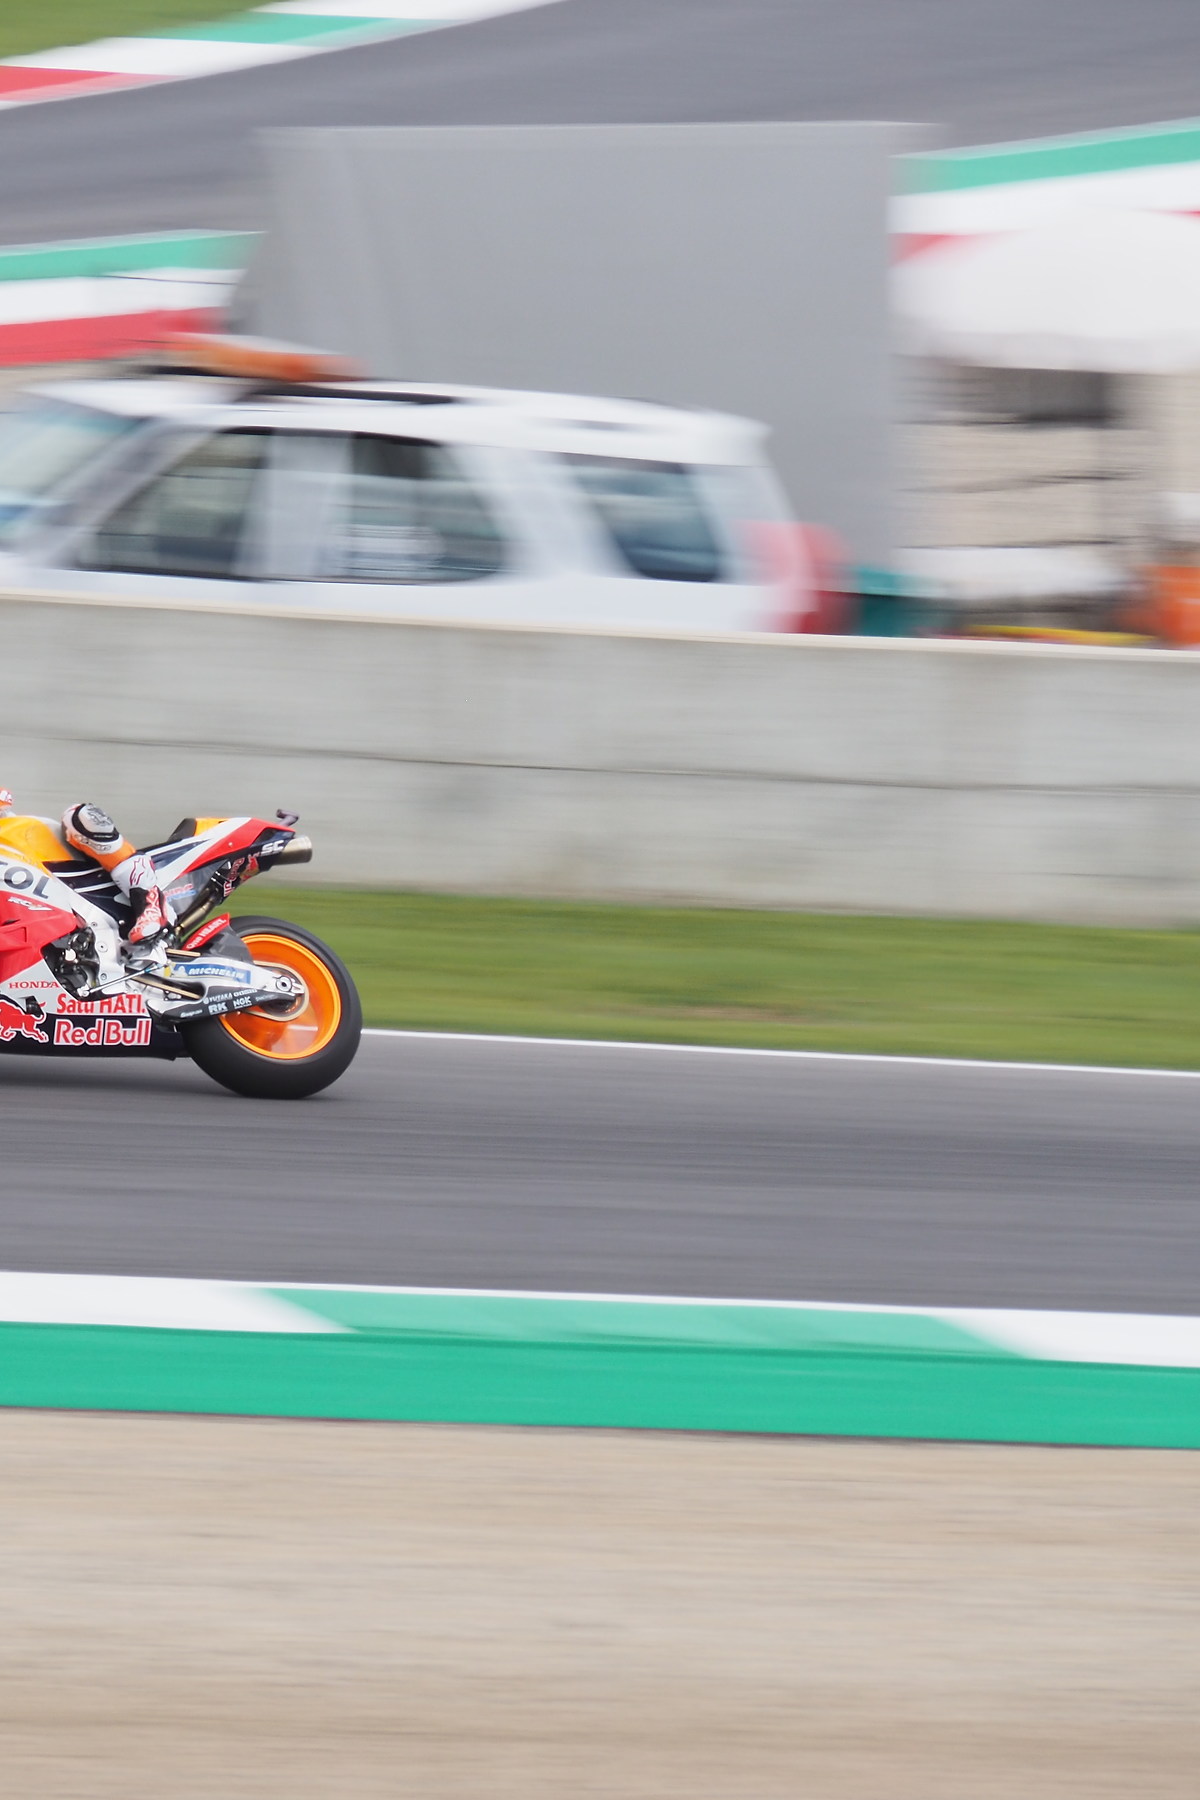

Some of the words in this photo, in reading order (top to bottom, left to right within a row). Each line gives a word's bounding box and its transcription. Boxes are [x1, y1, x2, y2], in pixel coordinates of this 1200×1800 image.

[188, 966, 245, 979] MICHELIN
[9, 981, 60, 989] HONDA
[56, 993, 94, 1014] Satu
[100, 993, 146, 1014] HATI.
[209, 992, 233, 1004] YUTAKA
[233, 996, 252, 1007] NGK
[208, 1002, 228, 1013] RK
[54, 1019, 103, 1046] Red
[103, 1018, 152, 1046] Bull
